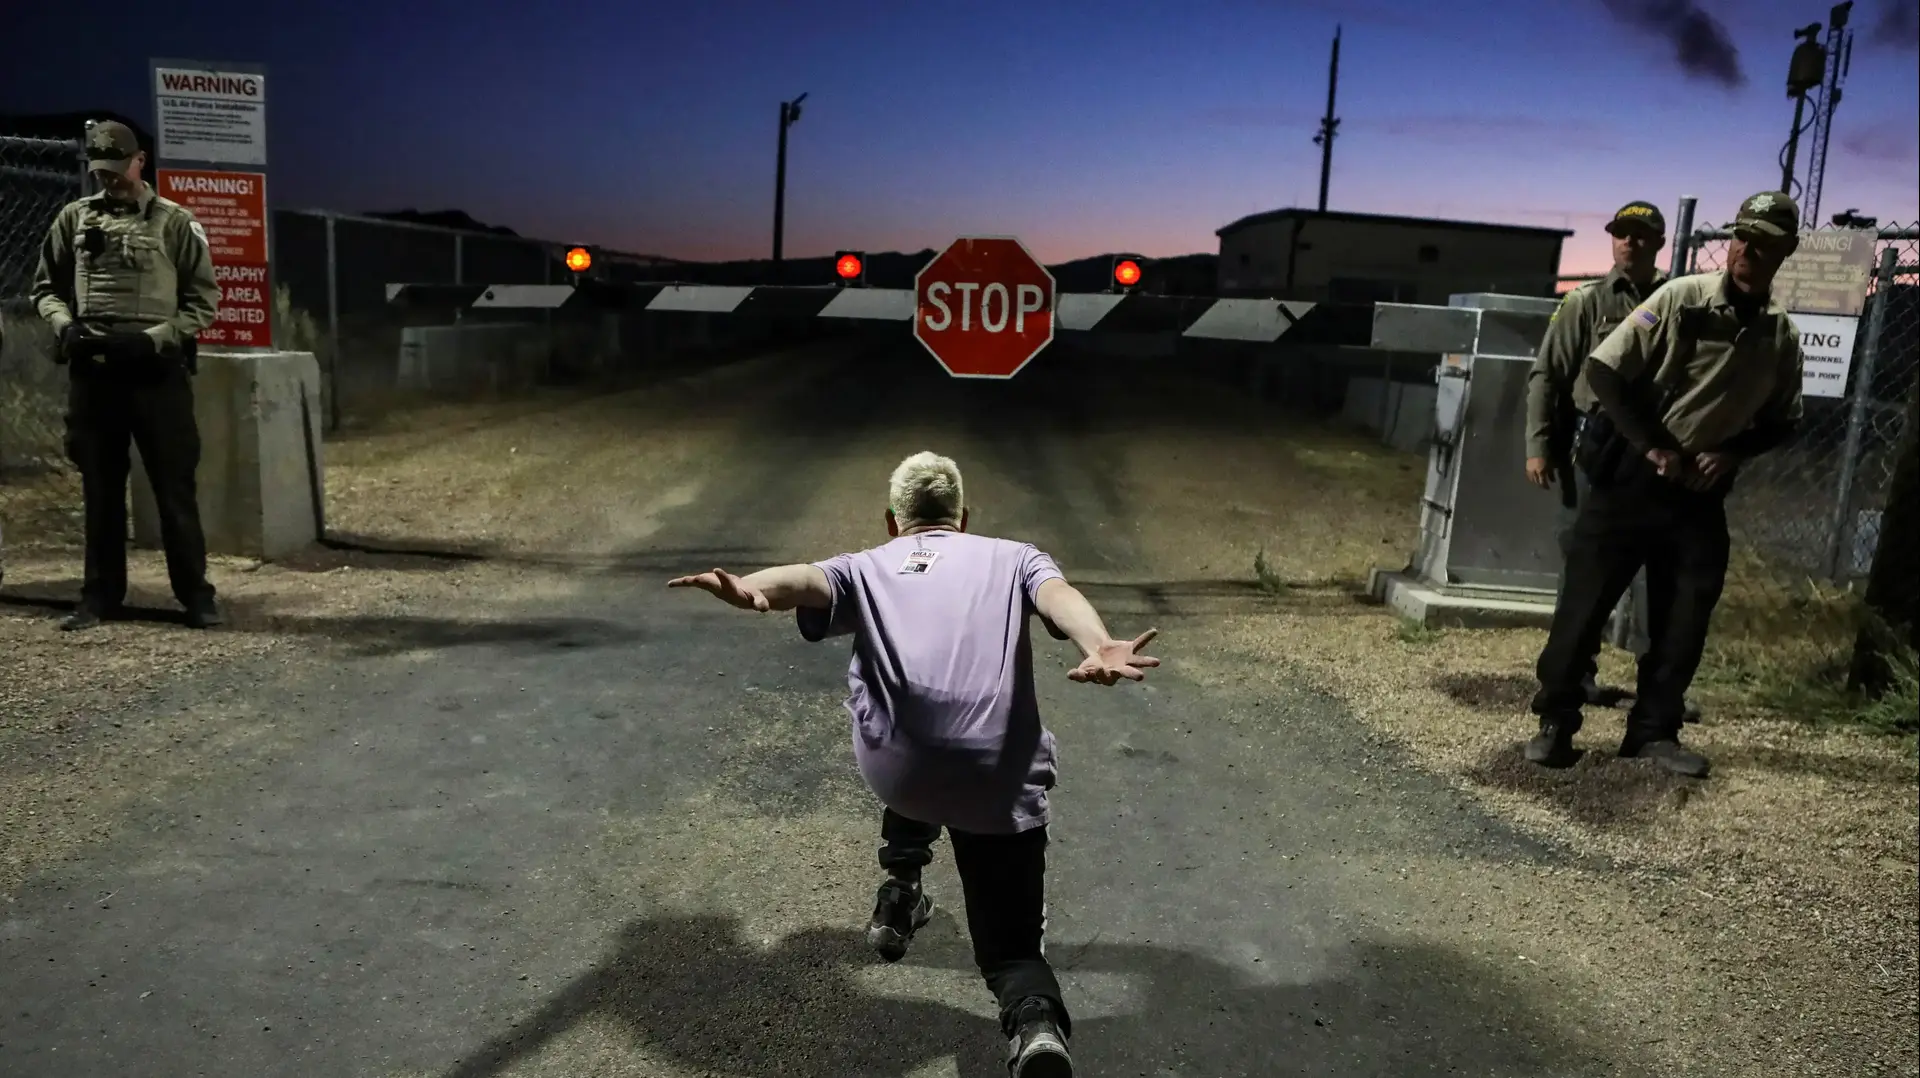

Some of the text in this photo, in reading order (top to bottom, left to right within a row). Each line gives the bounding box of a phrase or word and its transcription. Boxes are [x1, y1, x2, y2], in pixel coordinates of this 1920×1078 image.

[162, 73, 257, 96] WARNING
[168, 176, 253, 195] WARNING!
[1799, 235, 1852, 252] RNING!
[213, 265, 266, 282] GRAPHY
[227, 287, 262, 303] AREA
[215, 307, 265, 323] HIBITED
[925, 281, 1044, 333] STOP
[203, 329, 226, 340] USC
[1803, 333, 1841, 348] ING
[1818, 371, 1841, 380] POINT
